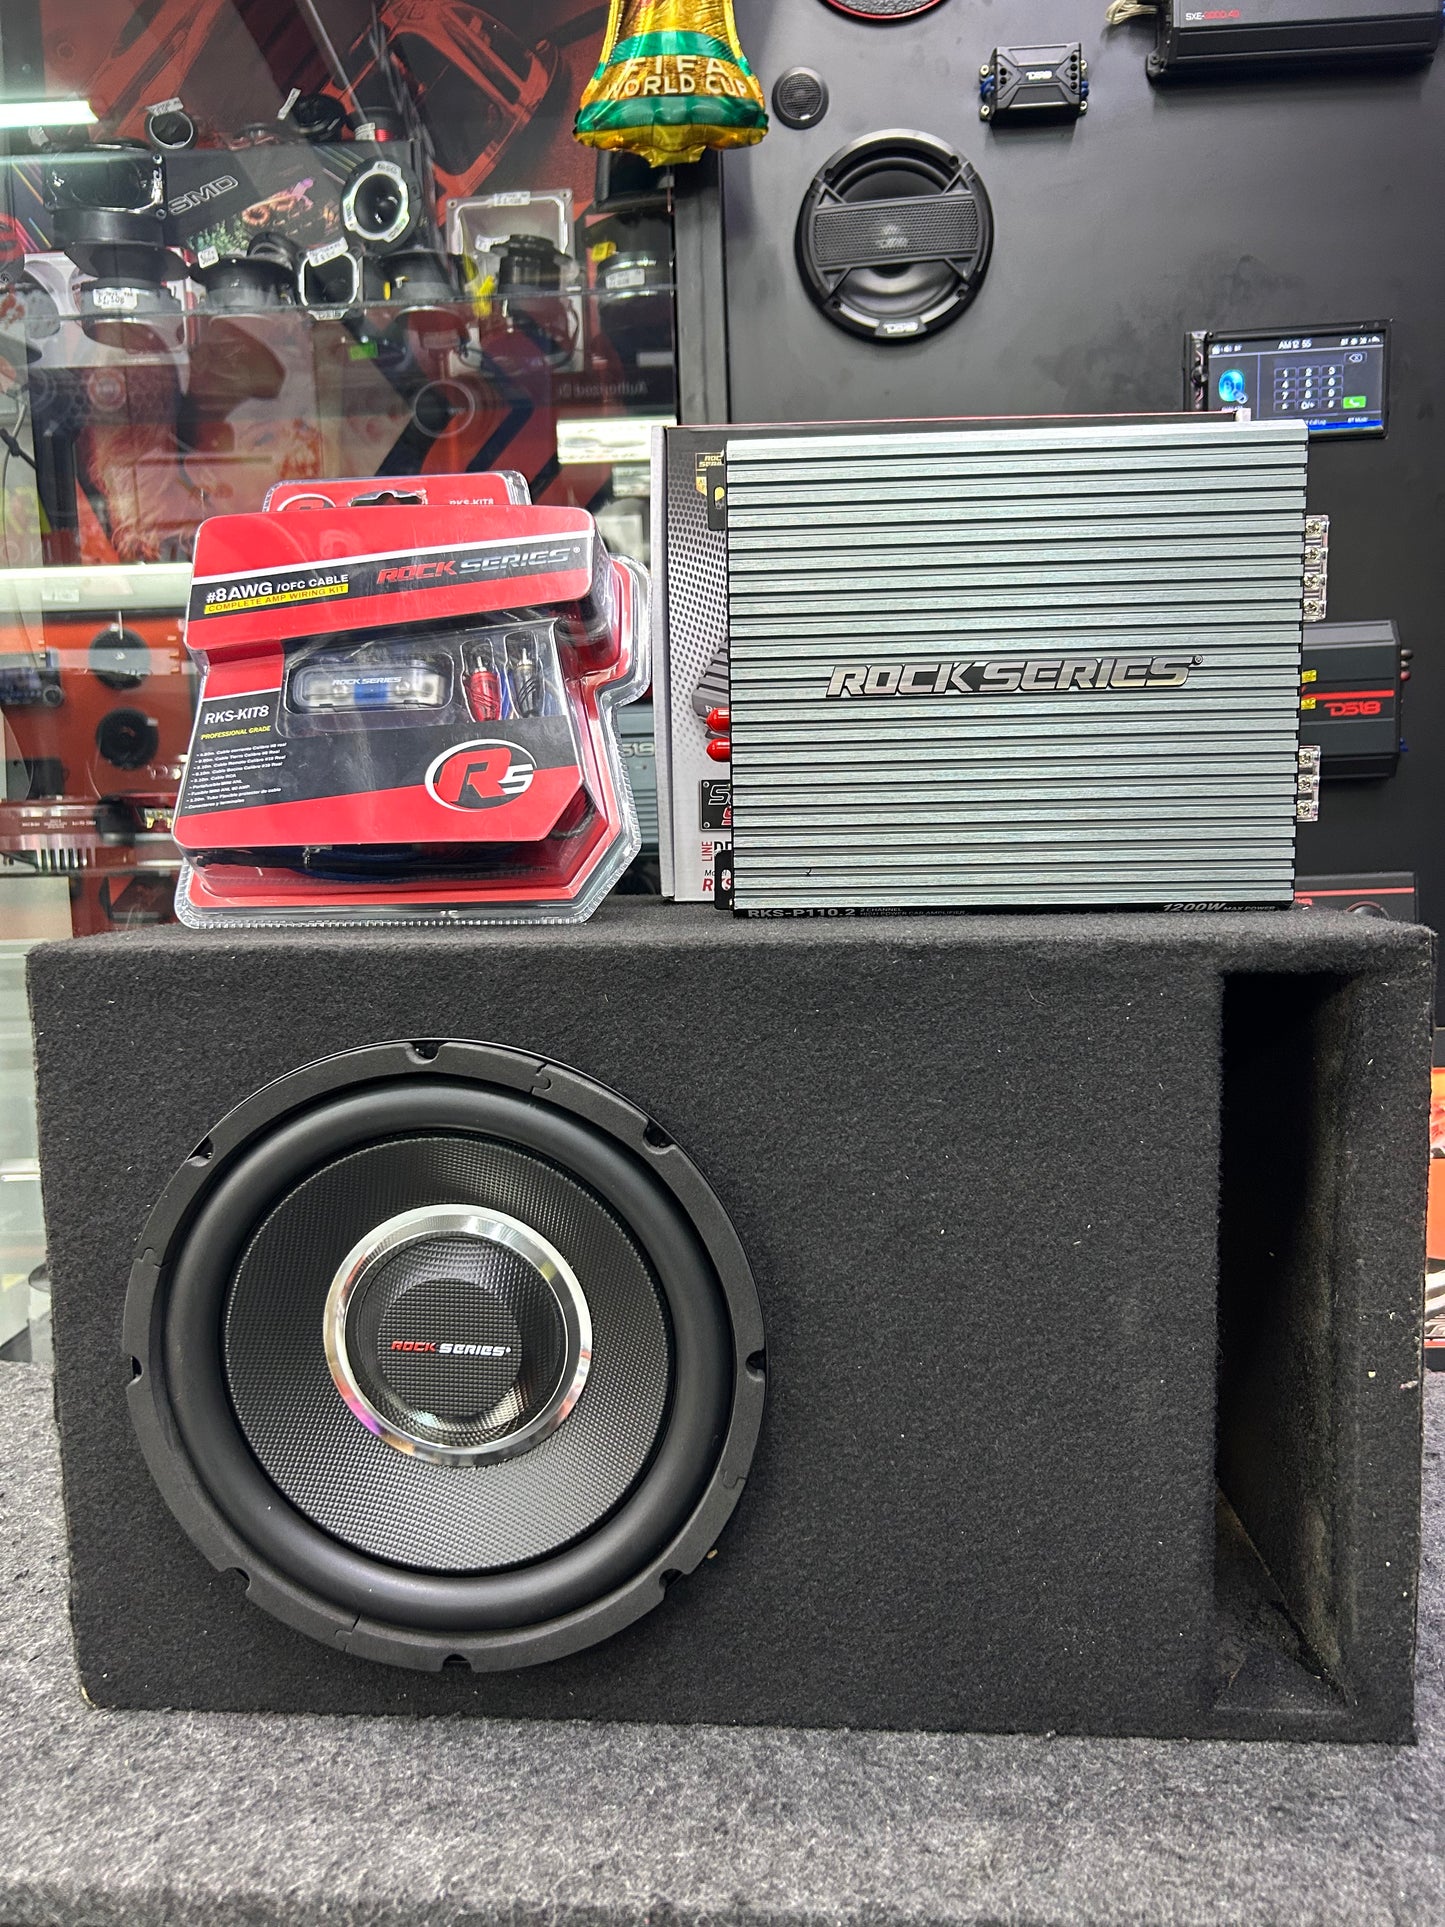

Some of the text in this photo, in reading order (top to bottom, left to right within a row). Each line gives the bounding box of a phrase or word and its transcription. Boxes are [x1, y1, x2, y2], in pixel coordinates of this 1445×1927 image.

[622, 55, 729, 75] FIFA
[606, 75, 748, 100] WORLD CUP
[168, 174, 239, 216] SMD
[308, 573, 349, 587] CABLE
[376, 560, 457, 584] ROCK
[208, 585, 345, 612] COMPLETE AMP WIRING KIT
[826, 661, 979, 698] ROCK
[204, 705, 270, 725] RKS-KIT8
[1324, 701, 1382, 717] DS18
[201, 725, 271, 740] PROFESSIONAL GRADE
[701, 841, 713, 861] LINE
[748, 908, 855, 917] RKS-P110.2
[1163, 902, 1227, 912] 1200W
[391, 1340, 436, 1353] ROCK
